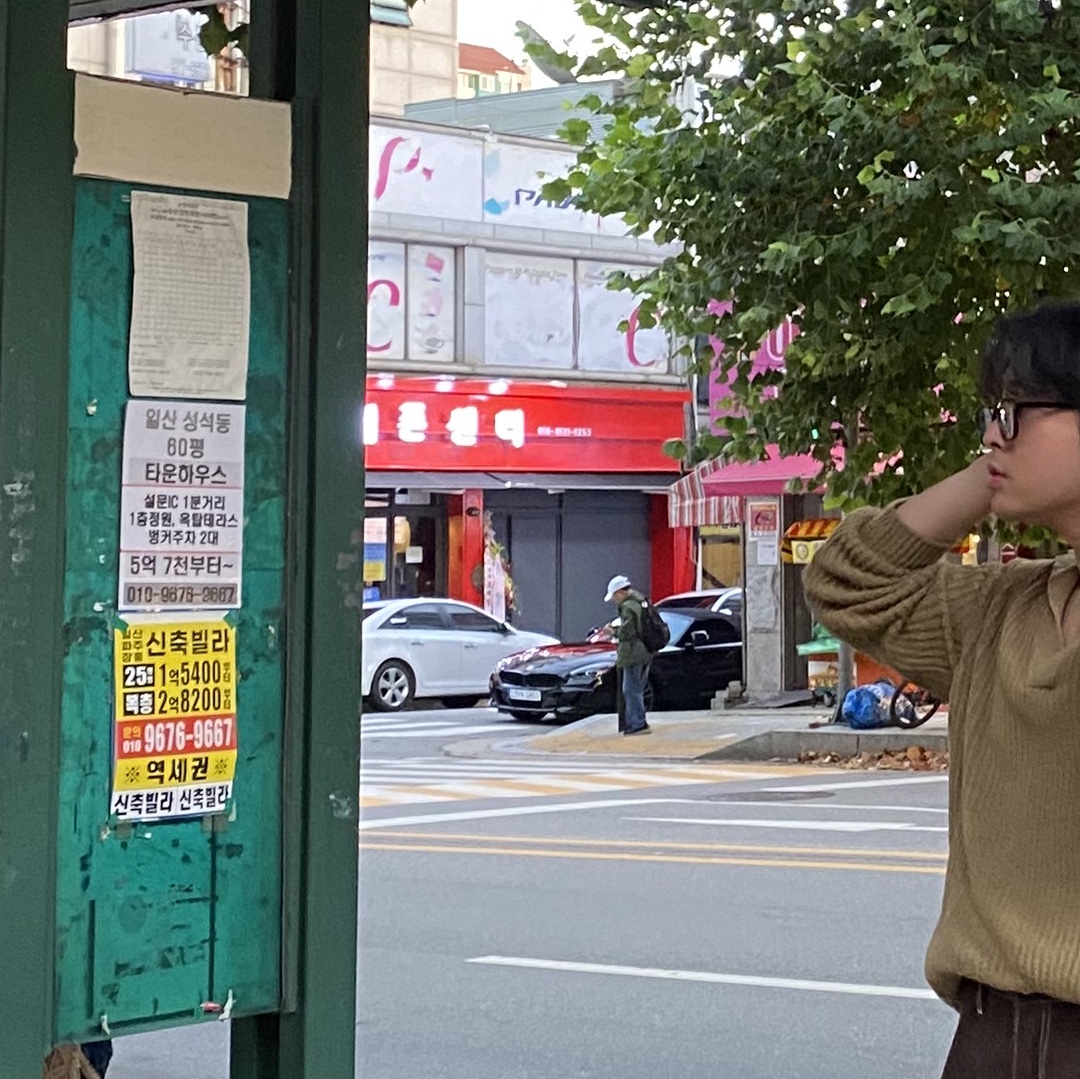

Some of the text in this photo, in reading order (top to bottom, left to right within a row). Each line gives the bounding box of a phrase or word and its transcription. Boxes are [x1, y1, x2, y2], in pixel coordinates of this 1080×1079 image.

[146, 408, 232, 434] 일산 성석동
[145, 462, 227, 485] 타운하우스
[183, 495, 226, 511] 1분거리
[180, 513, 239, 528] 옥탑테라스
[148, 529, 219, 546] 벙커주차 2대
[130, 555, 157, 576] 5억
[146, 628, 230, 657] 신축빌라
[143, 718, 233, 754] 9676-9667
[146, 756, 210, 785] 역세권
[114, 784, 229, 817] 신축빌라 신축빌라
